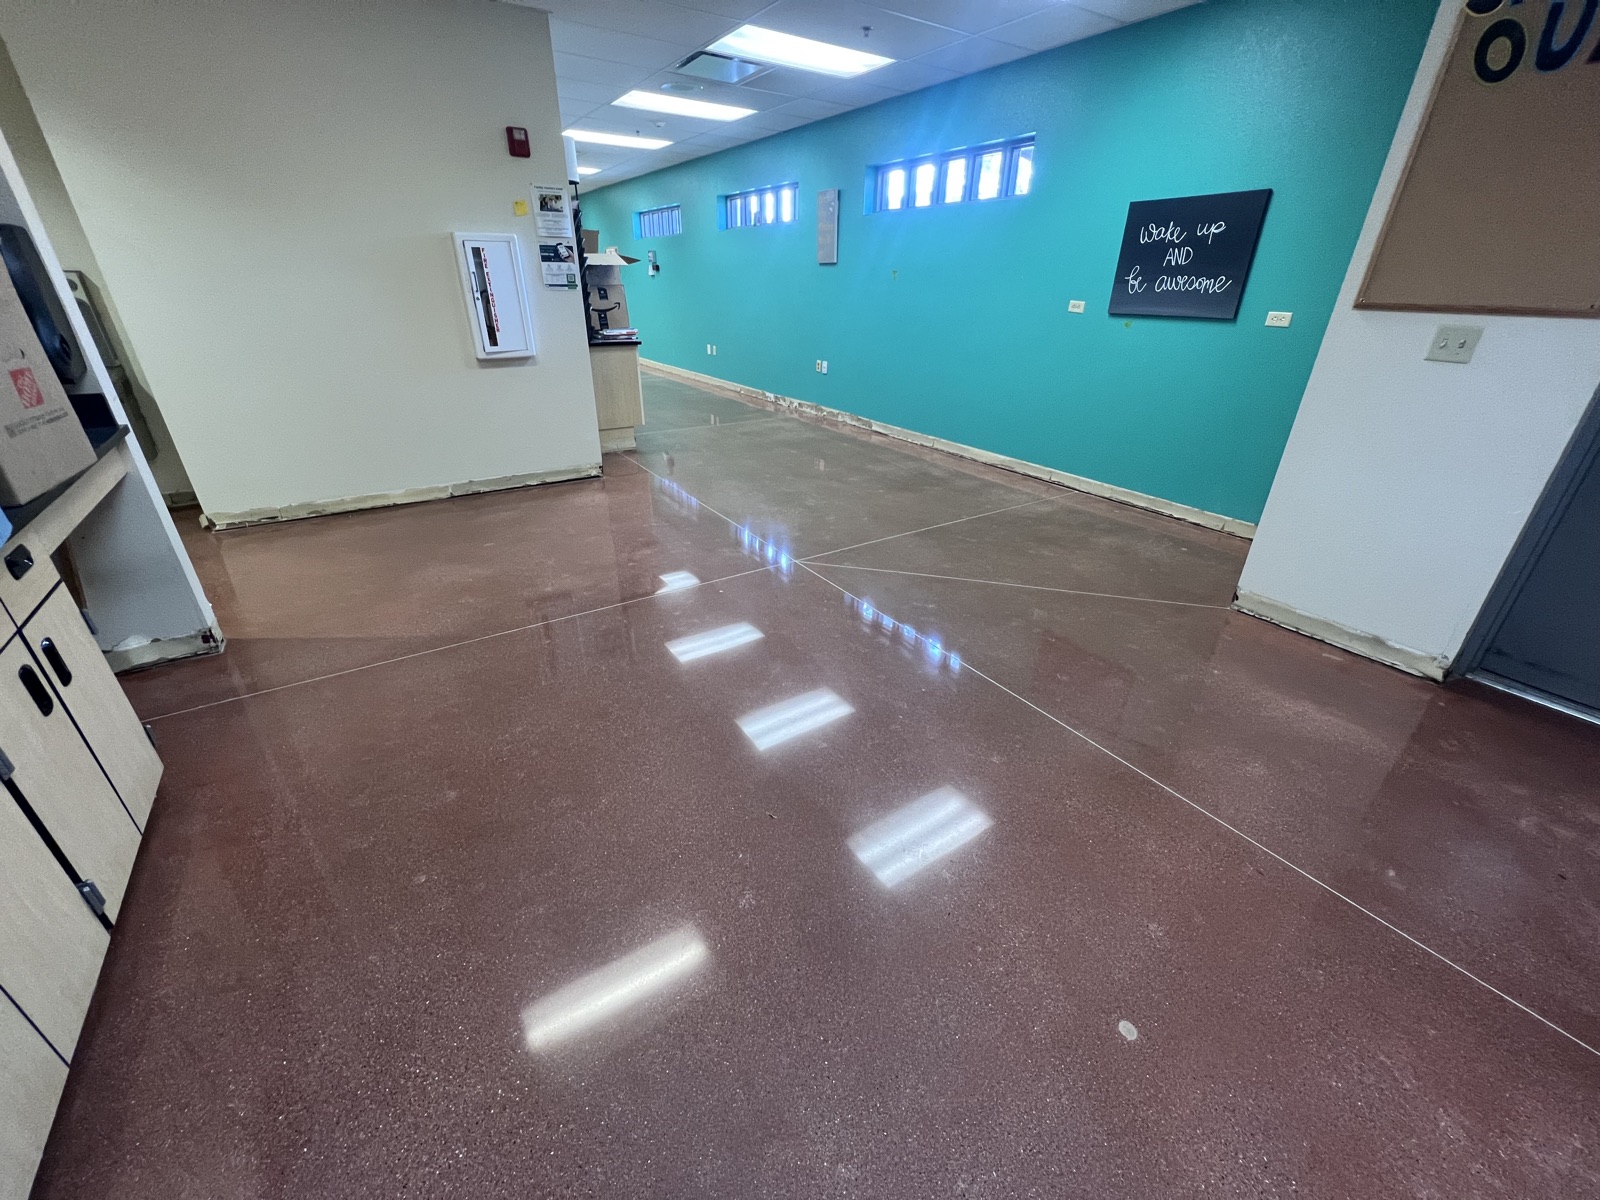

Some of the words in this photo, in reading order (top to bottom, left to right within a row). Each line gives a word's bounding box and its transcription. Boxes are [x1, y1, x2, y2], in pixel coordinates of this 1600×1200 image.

[1474, 0, 1600, 84] OU
[1197, 221, 1226, 245] up
[481, 247, 489, 269] FIRE
[1163, 246, 1194, 267] AND
[1124, 265, 1147, 294] be
[1155, 275, 1232, 294] awesome
